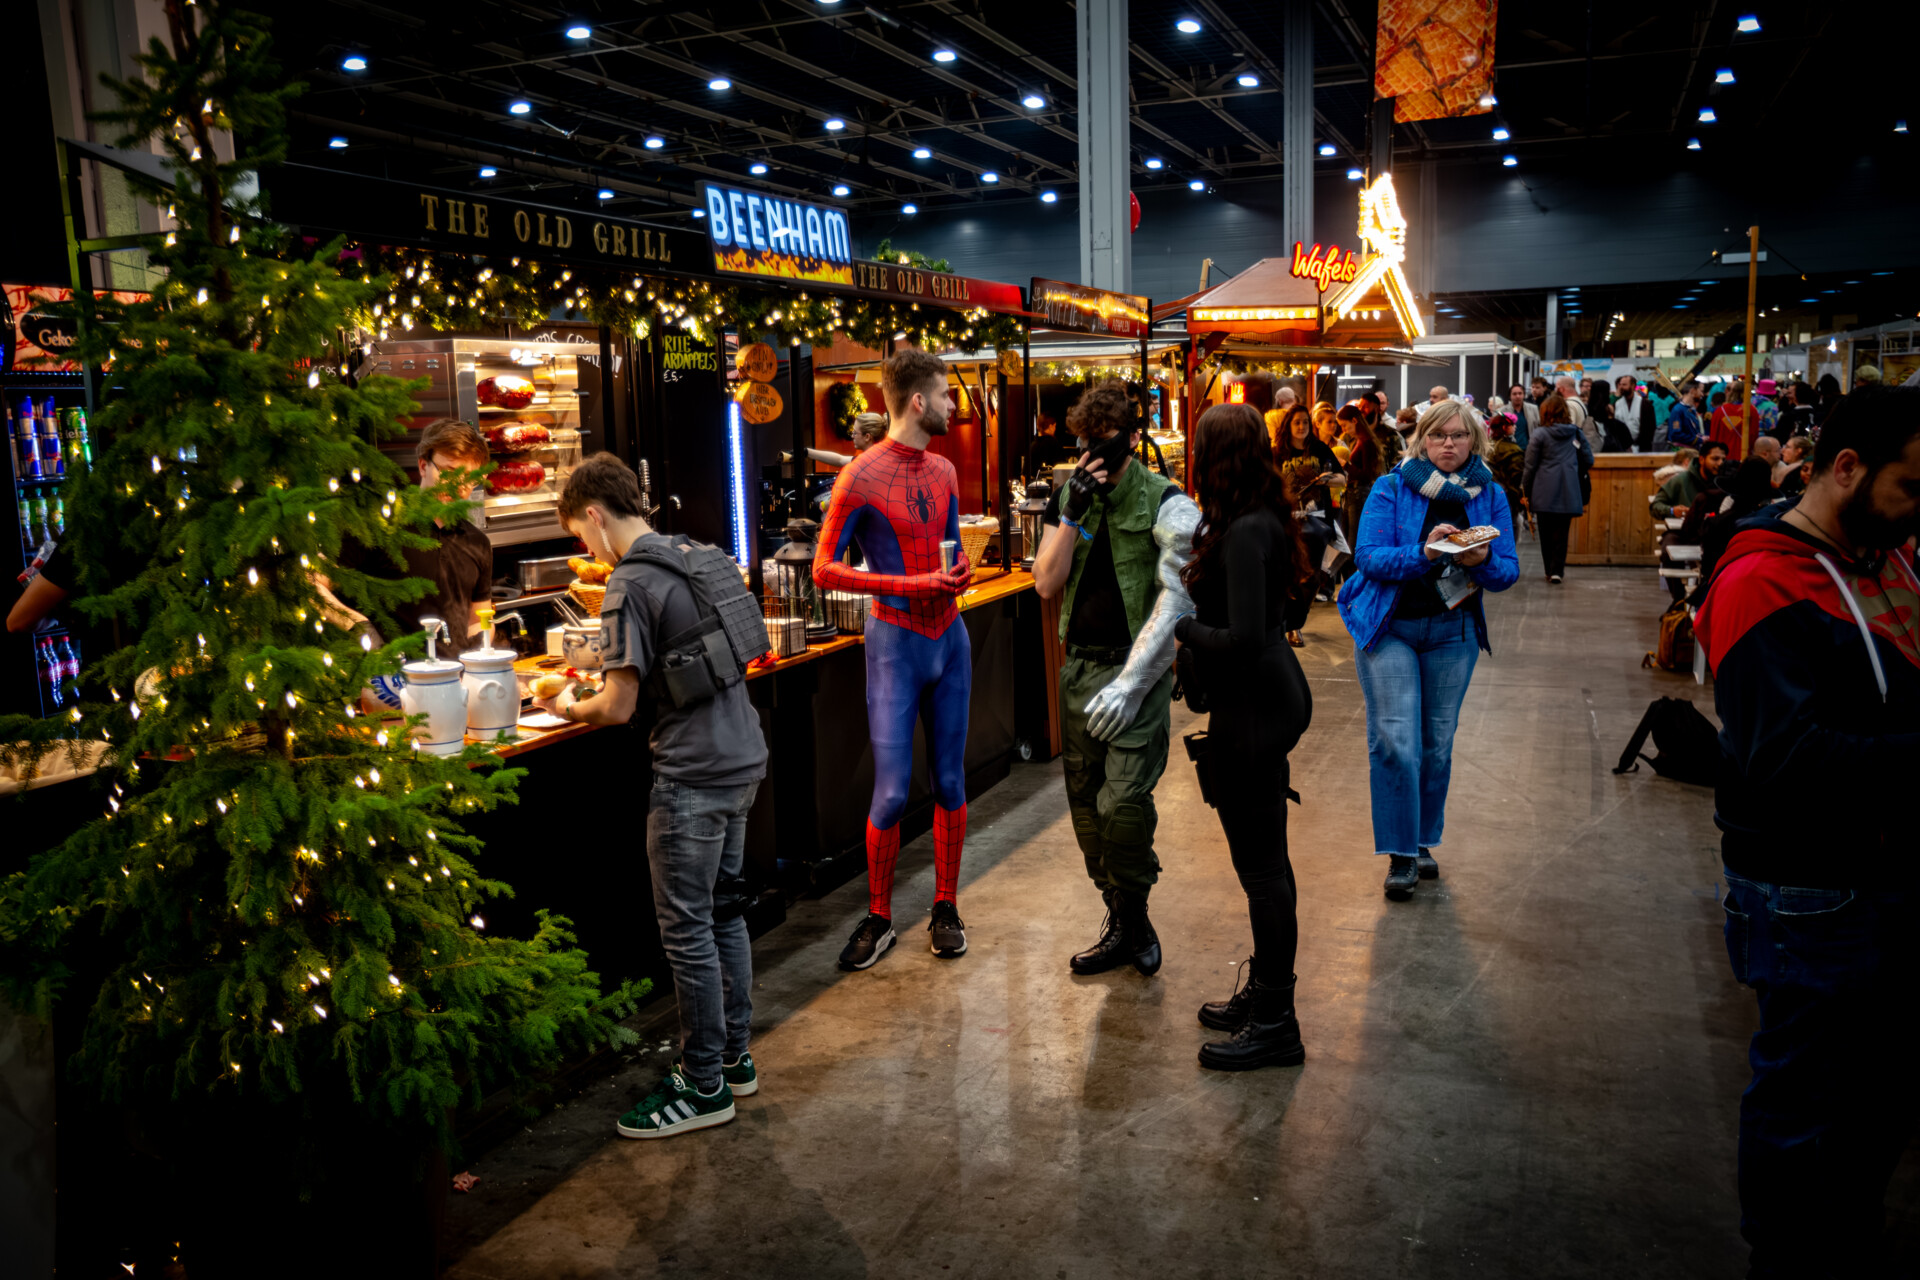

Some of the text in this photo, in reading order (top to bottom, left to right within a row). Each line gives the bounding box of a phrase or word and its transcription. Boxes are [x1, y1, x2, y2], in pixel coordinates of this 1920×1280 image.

[420, 193, 672, 263] THE OLD GRILL
[707, 187, 850, 263] BEENHAM
[858, 263, 970, 301] THE OLD GRILL
[1290, 241, 1356, 293] Wafels
[753, 348, 768, 361] PIN
